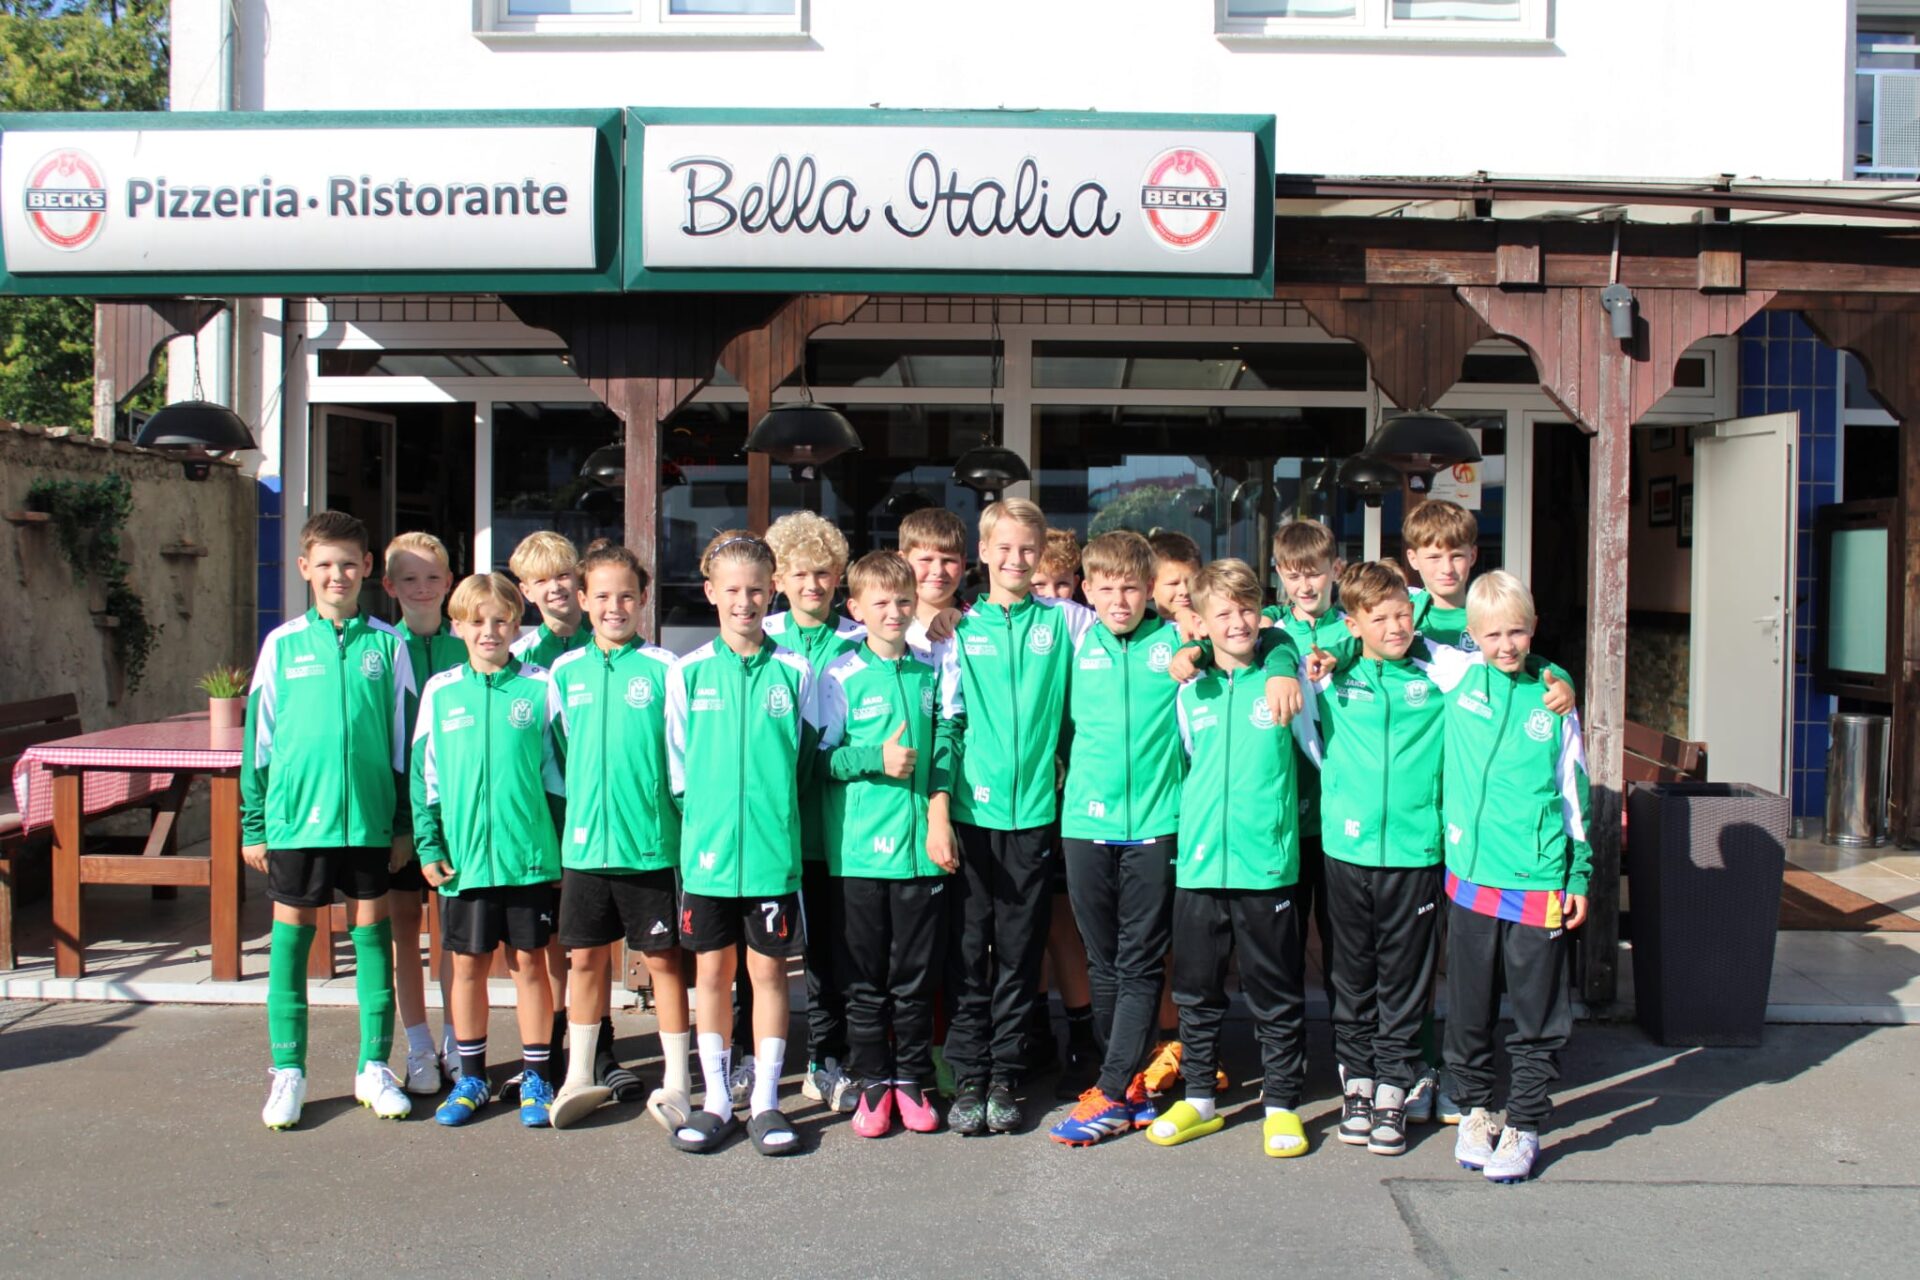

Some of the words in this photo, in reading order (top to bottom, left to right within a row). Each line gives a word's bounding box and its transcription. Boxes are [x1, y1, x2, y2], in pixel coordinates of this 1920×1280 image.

[670, 156, 870, 236] Bella
[885, 152, 1121, 238] Italia
[1145, 189, 1223, 207] BECK'S
[874, 837, 894, 854] MJ
[760, 901, 779, 933] 7
